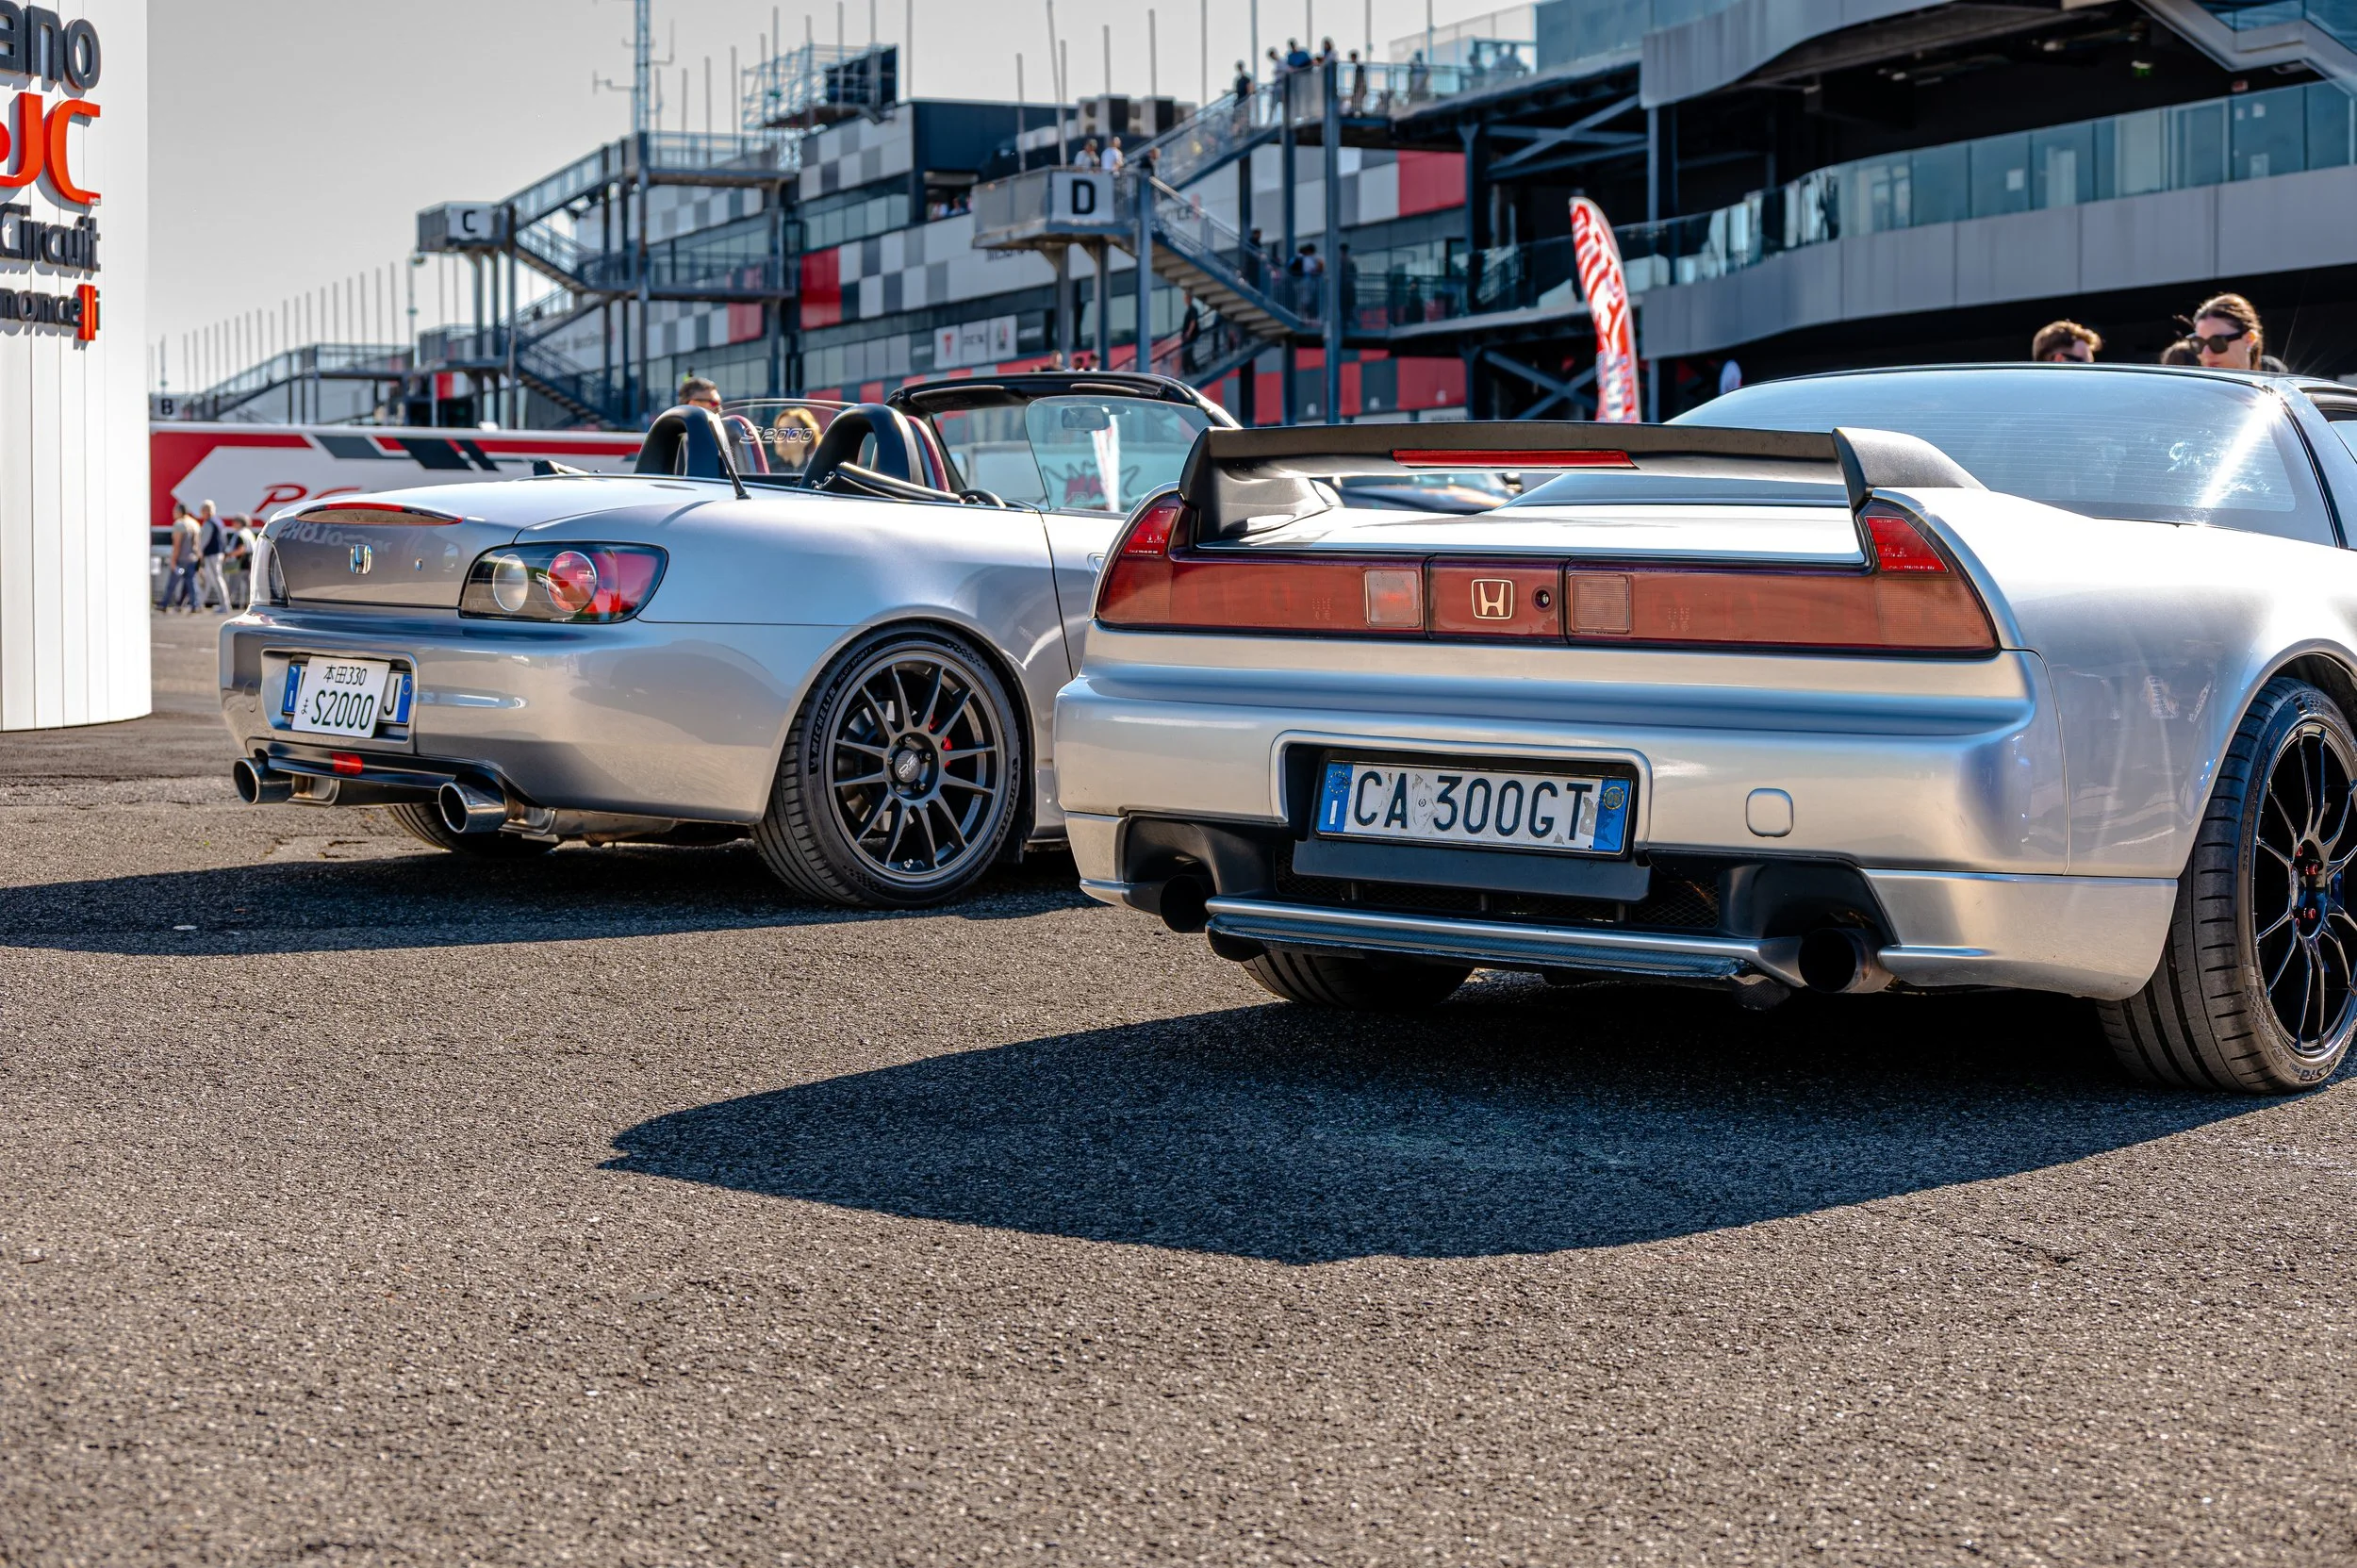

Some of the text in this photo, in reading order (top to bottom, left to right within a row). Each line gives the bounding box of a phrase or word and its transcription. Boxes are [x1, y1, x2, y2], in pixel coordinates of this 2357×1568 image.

[1071, 178, 1096, 216] D
[0, 202, 101, 272] Circuit
[462, 209, 477, 234] C
[161, 398, 173, 415] B
[739, 425, 815, 443] S2000
[323, 664, 368, 686] 本田330
[310, 689, 375, 731] S2000
[384, 678, 399, 716] J
[811, 686, 837, 754] MICHELIN
[837, 665, 850, 683] PILOT
[851, 650, 868, 668] SPORT
[898, 754, 916, 774] OZ
[1353, 770, 1594, 841] CA 300GT
